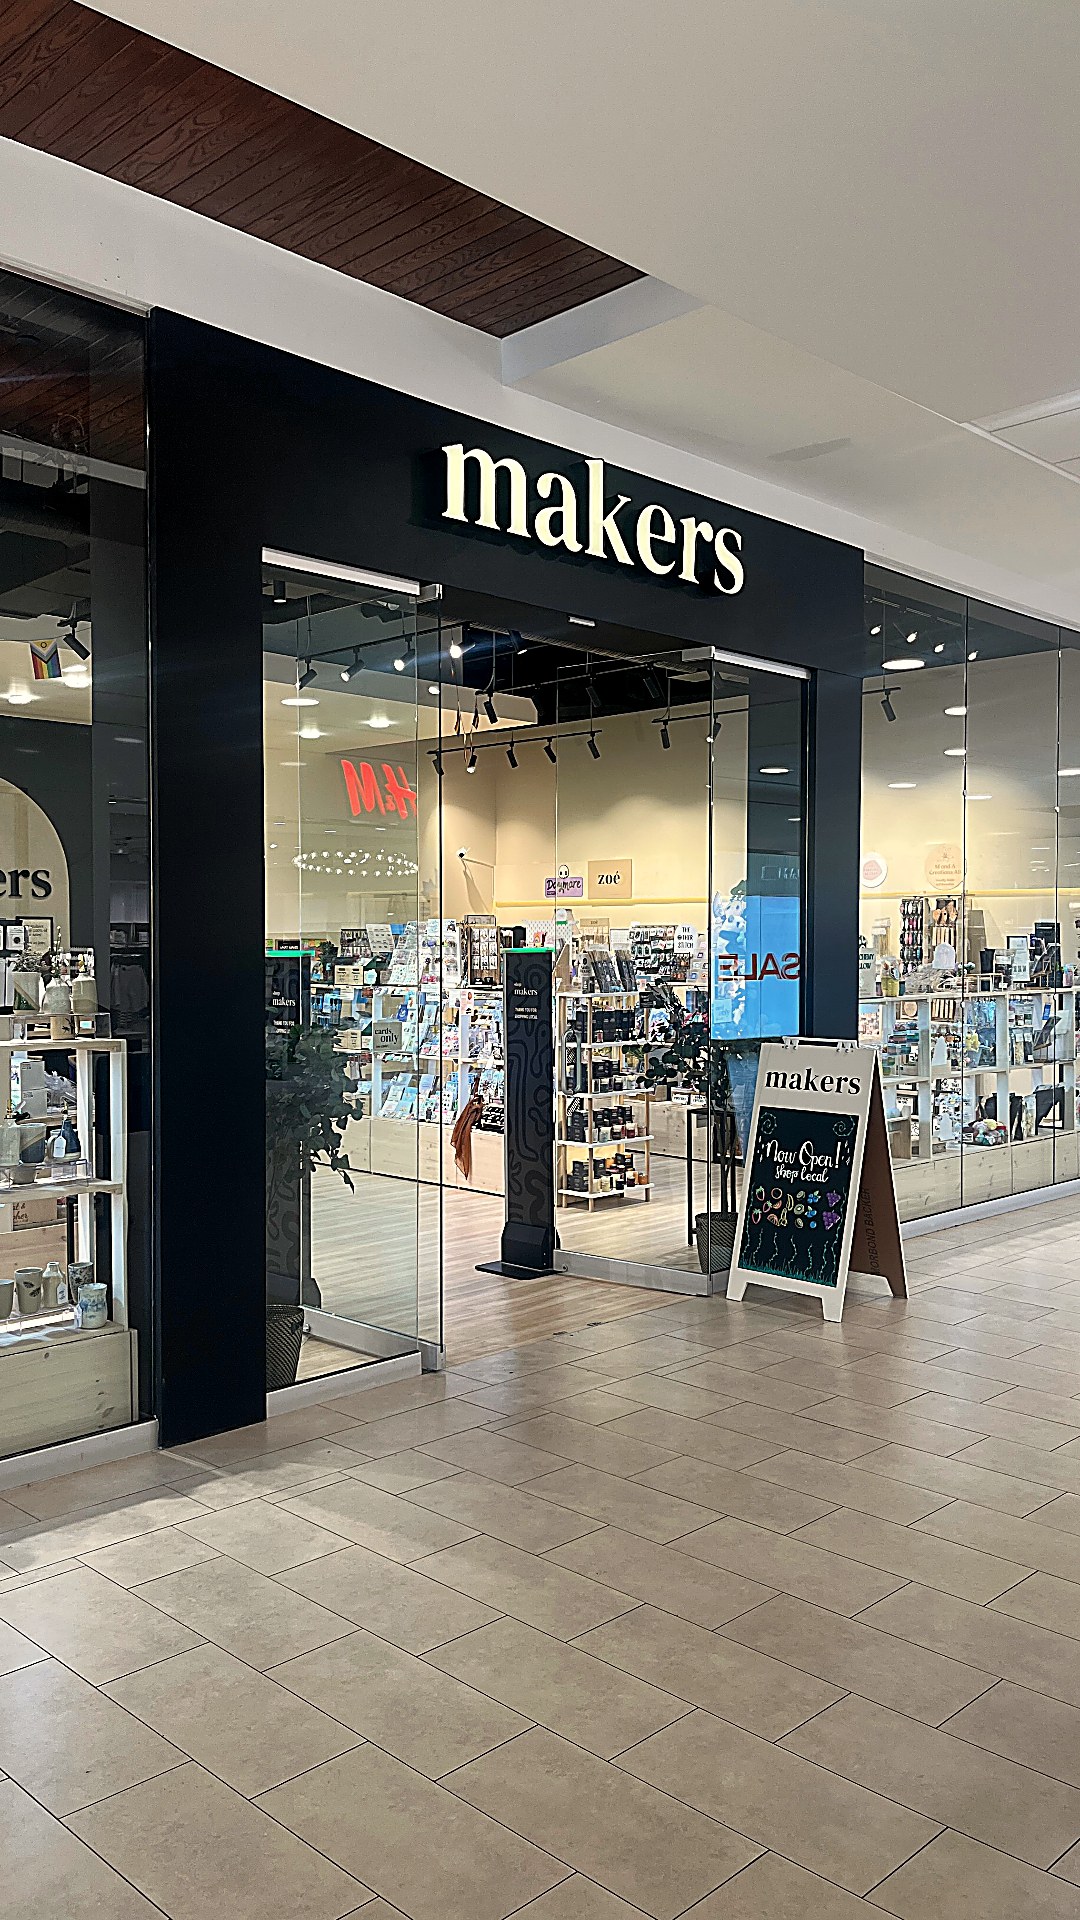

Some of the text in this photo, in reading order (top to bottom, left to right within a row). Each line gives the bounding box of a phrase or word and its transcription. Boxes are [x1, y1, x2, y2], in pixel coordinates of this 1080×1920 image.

[441, 443, 745, 595] makers
[598, 871, 621, 885] zoé
[514, 987, 538, 996] makers
[272, 997, 296, 1007] makers
[380, 1033, 399, 1044] only
[765, 1067, 861, 1095] makers
[766, 1139, 841, 1171] Now Open!
[800, 1166, 829, 1183] local
[861, 1187, 874, 1226] BACKER
